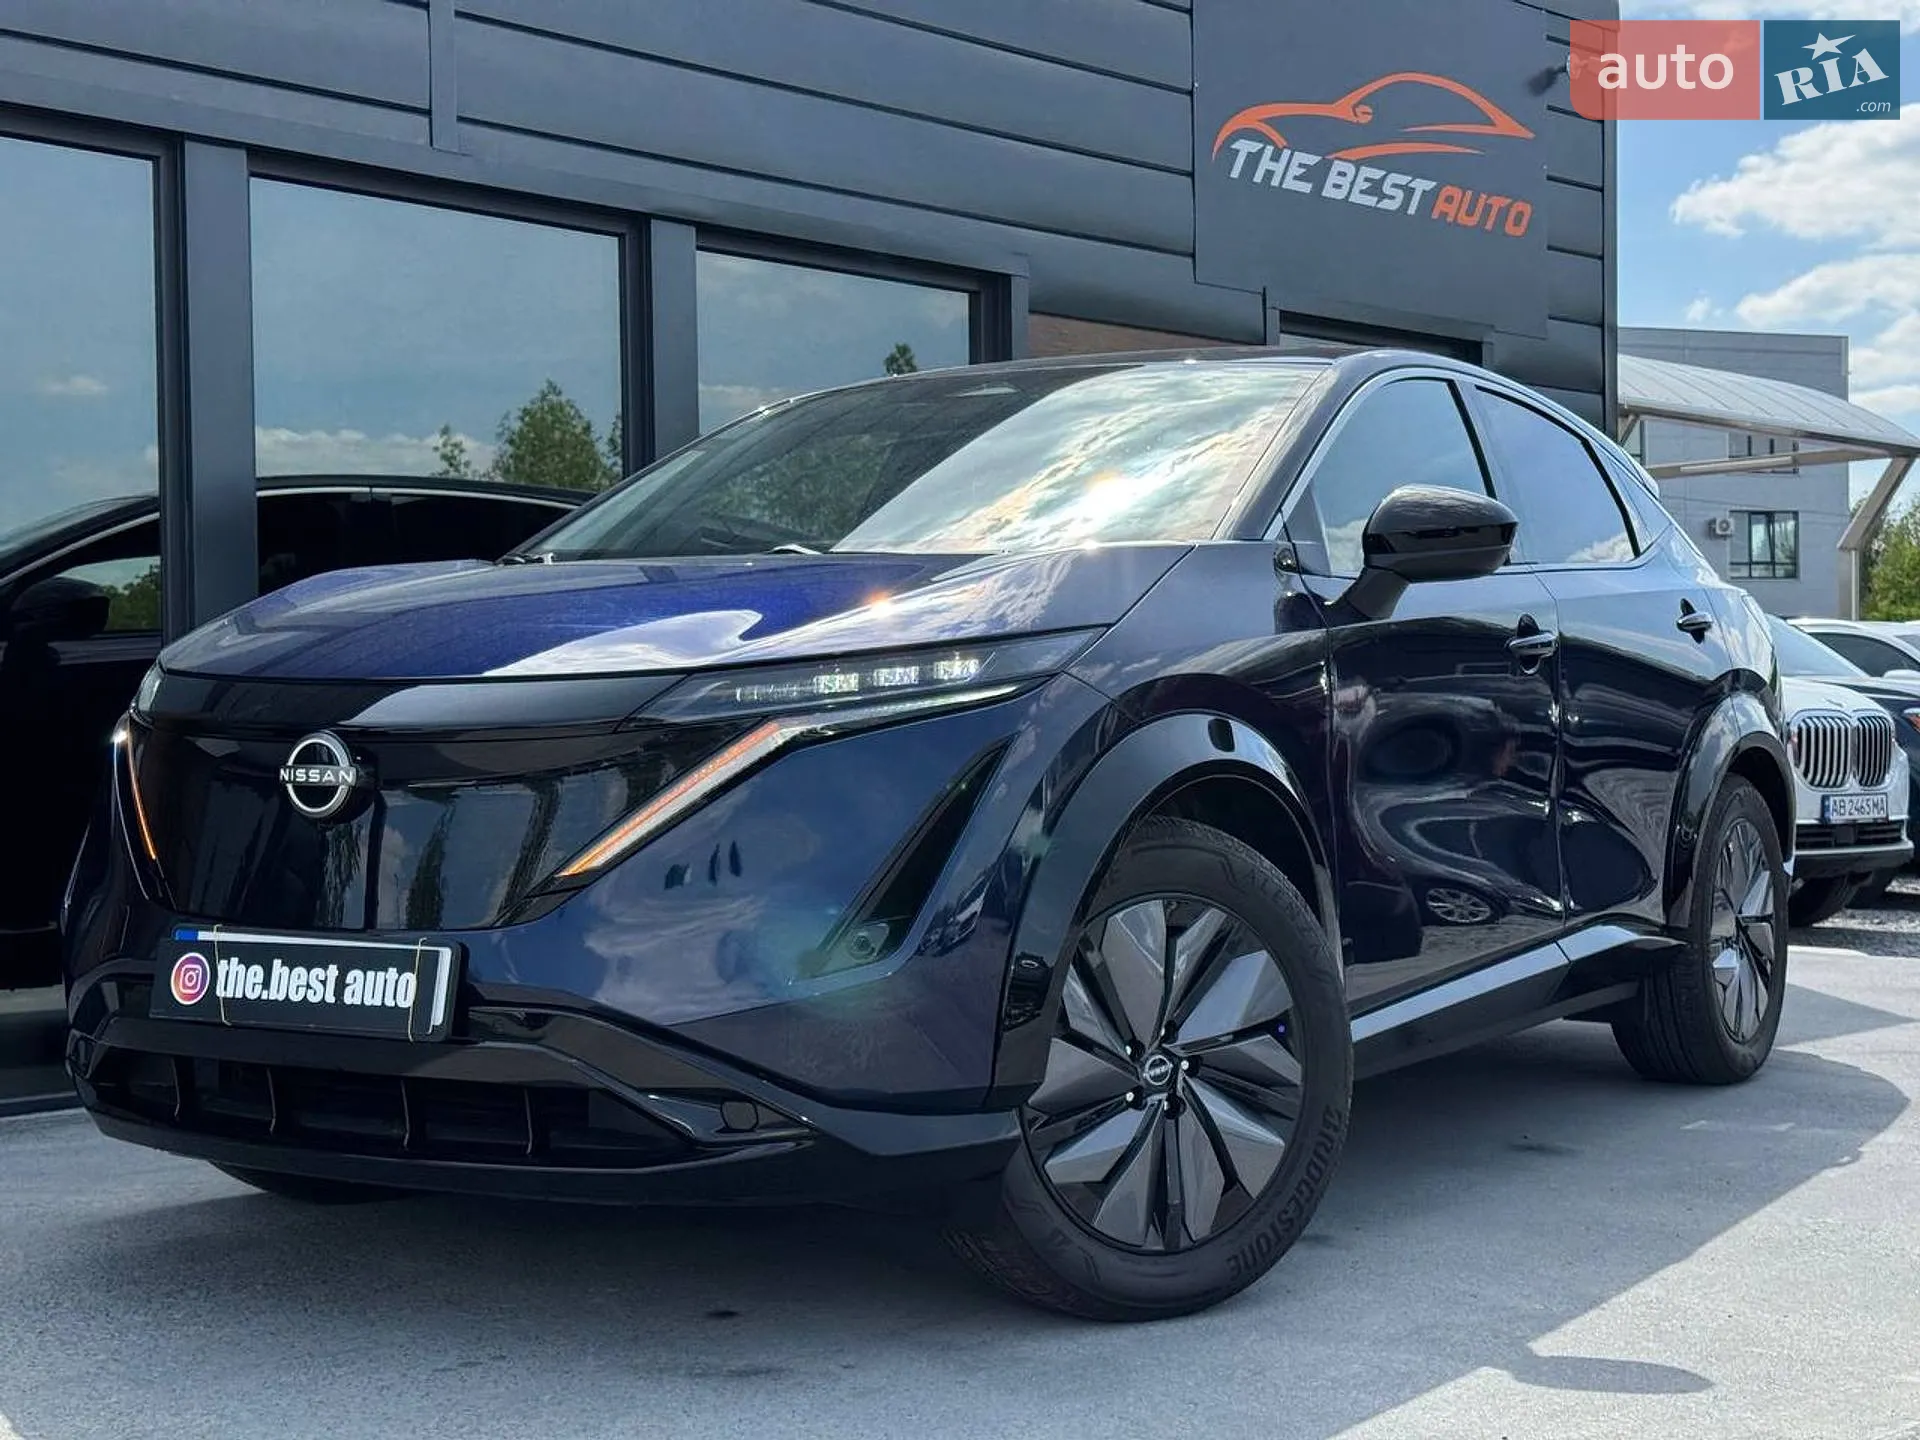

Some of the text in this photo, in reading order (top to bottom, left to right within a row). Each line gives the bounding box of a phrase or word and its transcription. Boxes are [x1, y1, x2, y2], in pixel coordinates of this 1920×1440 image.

[1230, 139, 1533, 237] THE BEST AUTO
[280, 767, 354, 784] NISSAN
[216, 957, 417, 1008] the.best auto
